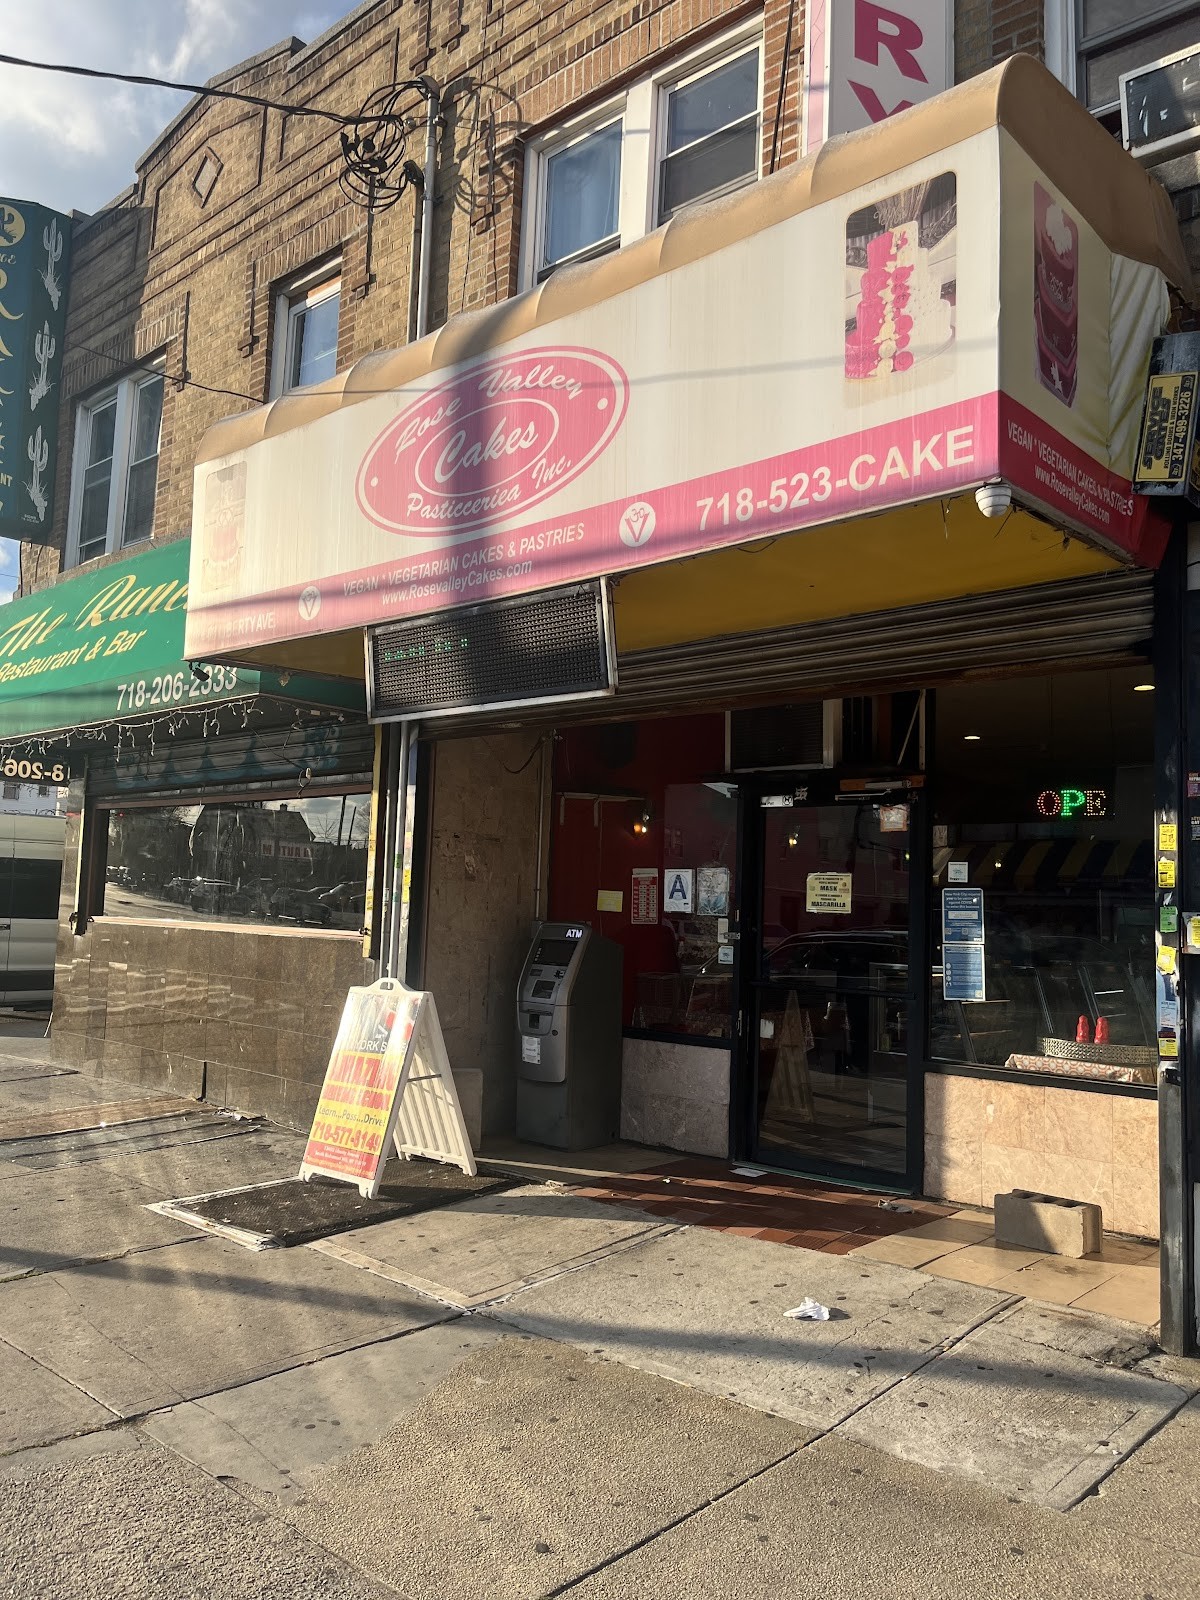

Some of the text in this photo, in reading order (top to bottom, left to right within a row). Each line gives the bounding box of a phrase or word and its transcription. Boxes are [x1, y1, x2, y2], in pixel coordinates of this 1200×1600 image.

[394, 364, 584, 464] Rose Valley
[1172, 391, 1191, 461] 347-499-3226
[434, 417, 539, 483] Cakes
[531, 457, 573, 489] Inc.
[696, 425, 975, 531] 718-523-CAKE
[1007, 419, 1033, 452] VEGAN
[1038, 440, 1077, 482] VEGETARIAN
[1077, 470, 1098, 495] CAKES
[1102, 486, 1134, 516] PASTRIES
[1163, 446, 1171, 469] ROLLING
[343, 522, 585, 597] VEGAN VEGETARIAN CAKES & PASTRIES
[0, 606, 67, 658] The
[73, 574, 188, 633] Ranc
[0, 629, 147, 684] Restaurant & Bar
[116, 665, 238, 711] 718-206-2333
[668, 874, 687, 899] A
[811, 900, 846, 908] MASCARILLA
[566, 929, 583, 938] ATM
